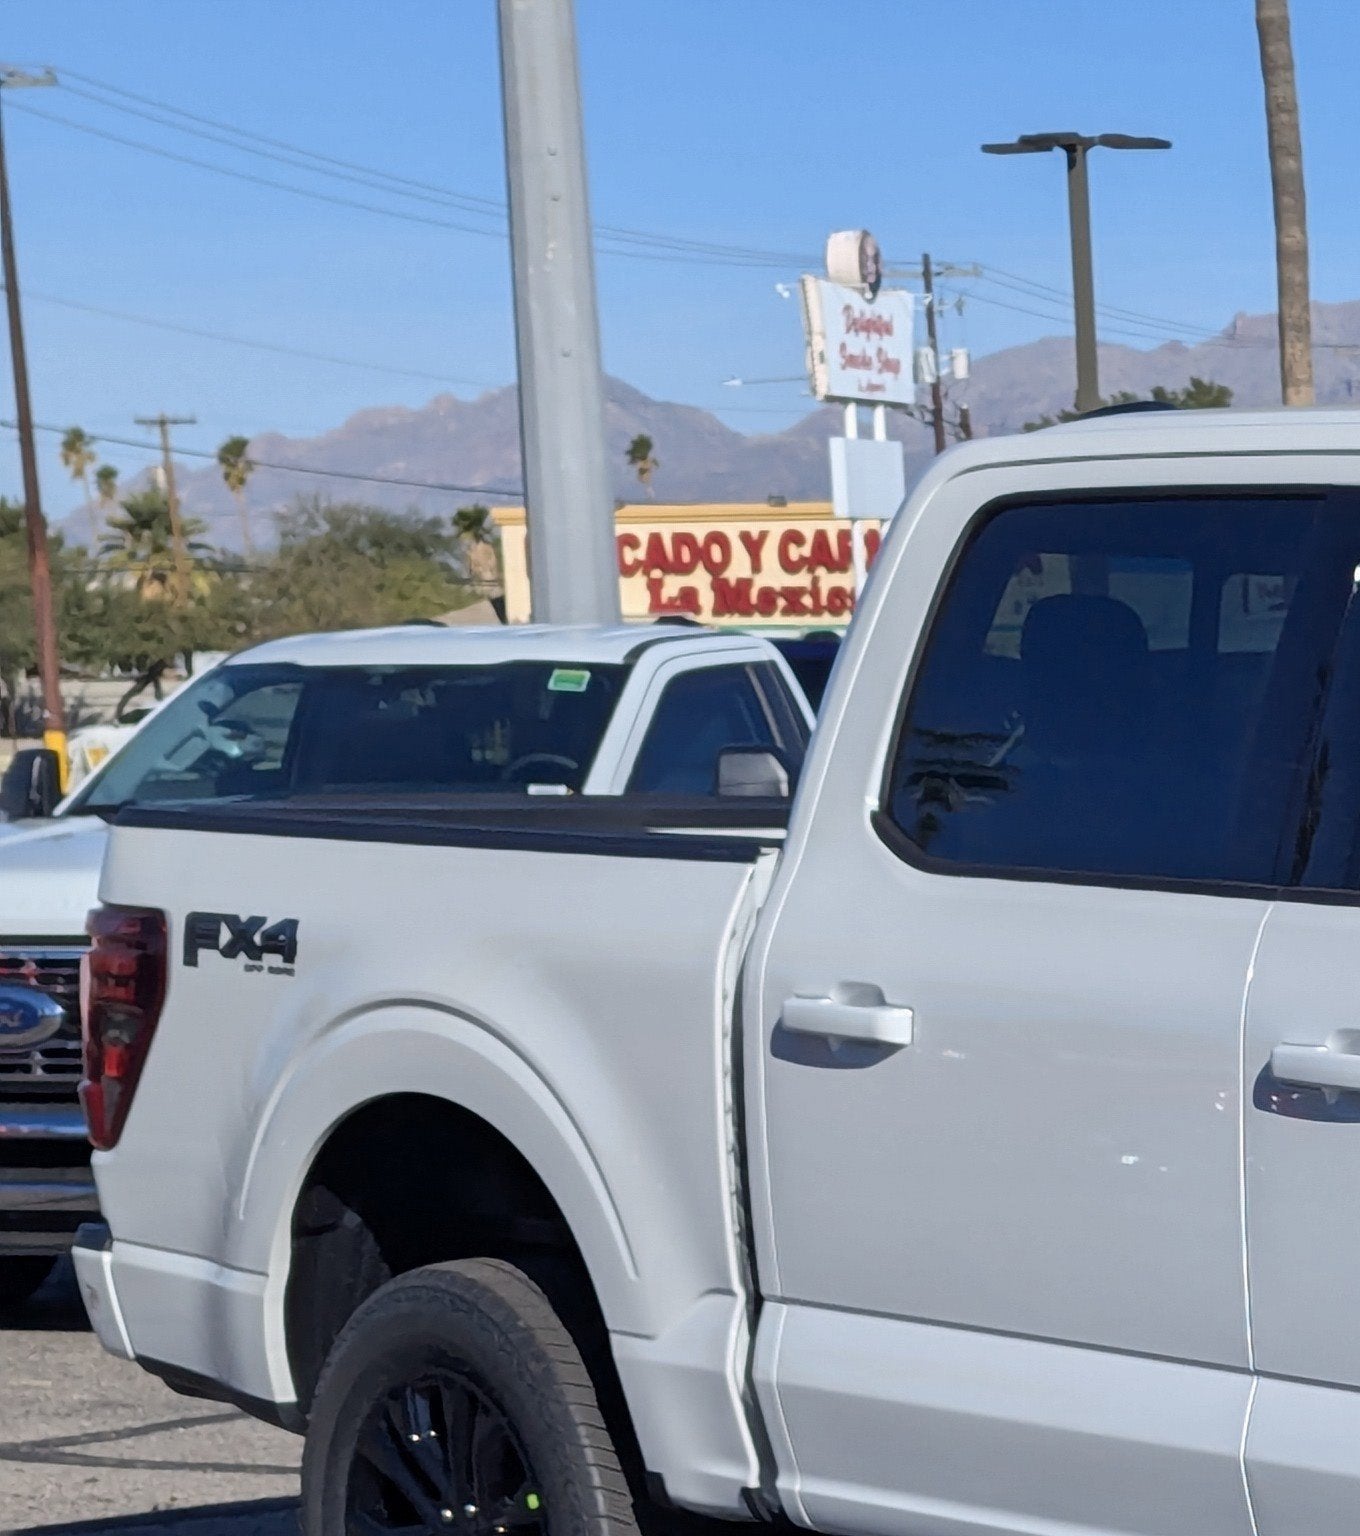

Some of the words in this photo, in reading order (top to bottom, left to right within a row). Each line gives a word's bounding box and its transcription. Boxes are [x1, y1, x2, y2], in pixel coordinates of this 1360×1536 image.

[616, 531, 733, 577] CADO
[738, 530, 770, 574] Y
[646, 576, 702, 614] La
[711, 575, 856, 617] Mexic
[183, 911, 299, 968] FX4
